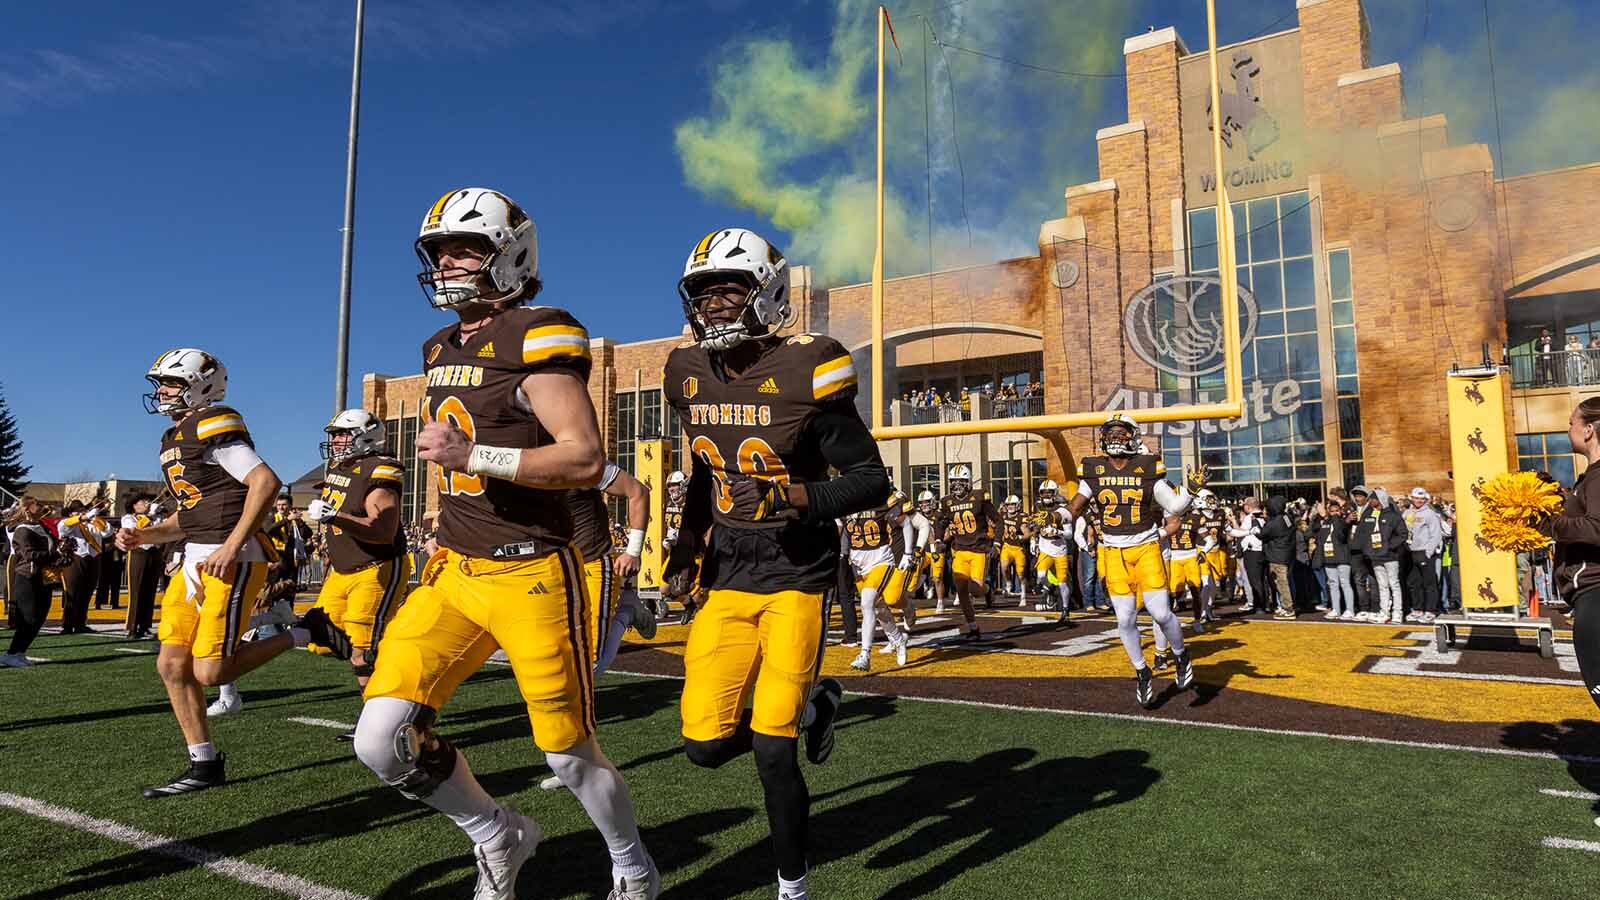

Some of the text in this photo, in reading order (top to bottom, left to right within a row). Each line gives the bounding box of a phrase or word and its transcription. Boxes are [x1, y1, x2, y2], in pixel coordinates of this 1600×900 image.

[758, 386, 780, 394] adidas
[689, 403, 771, 426] WYOMING
[1098, 476, 1142, 486] WYOMING
[1098, 488, 1144, 527] 27
[846, 519, 881, 548] 20
